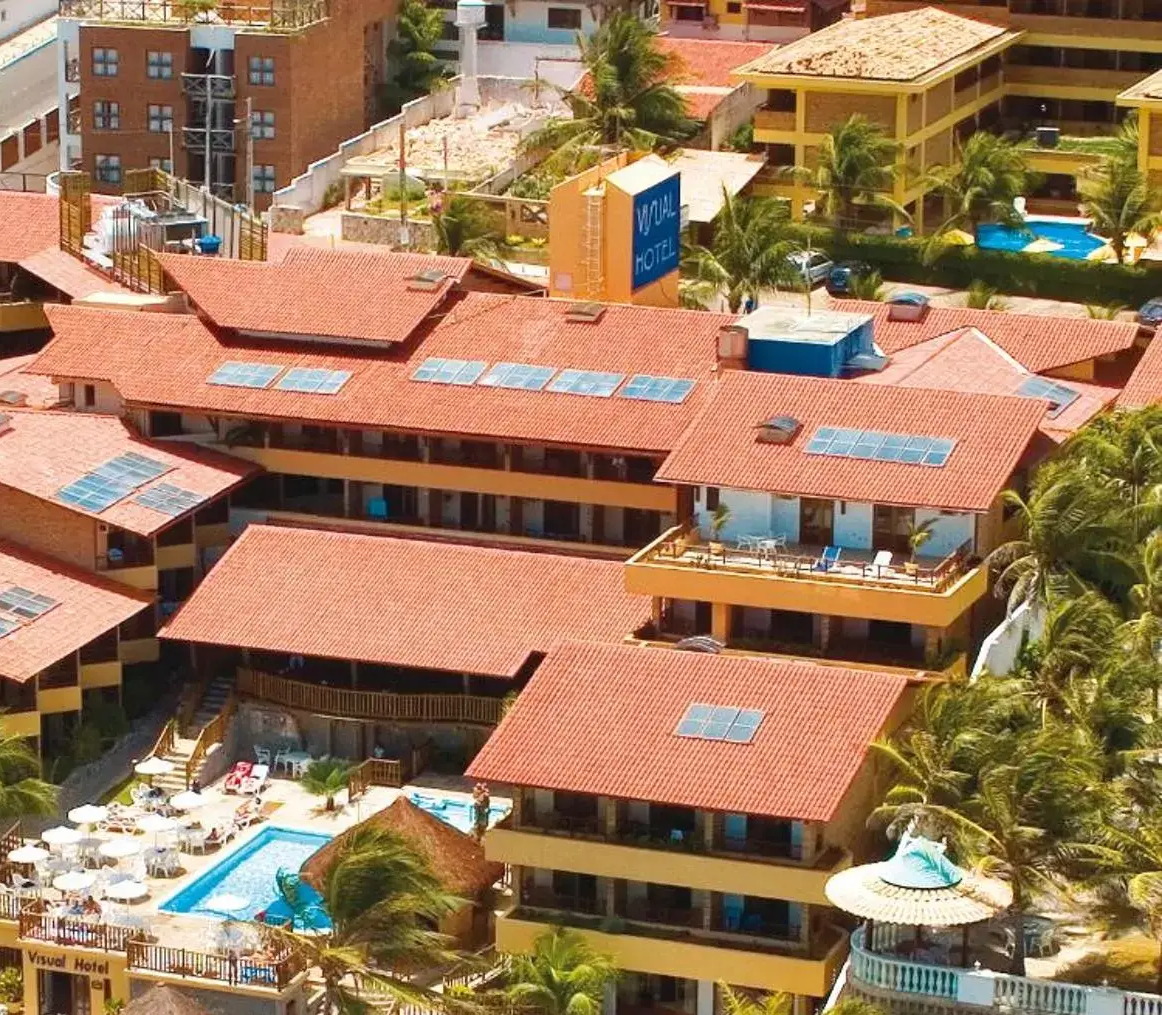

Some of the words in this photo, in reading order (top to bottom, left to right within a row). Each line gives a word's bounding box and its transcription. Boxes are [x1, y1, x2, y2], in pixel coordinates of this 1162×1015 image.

[637, 193, 676, 235] VISUAL
[635, 237, 676, 274] HOTEL
[28, 951, 67, 968] Visual
[74, 958, 109, 974] Hotel
